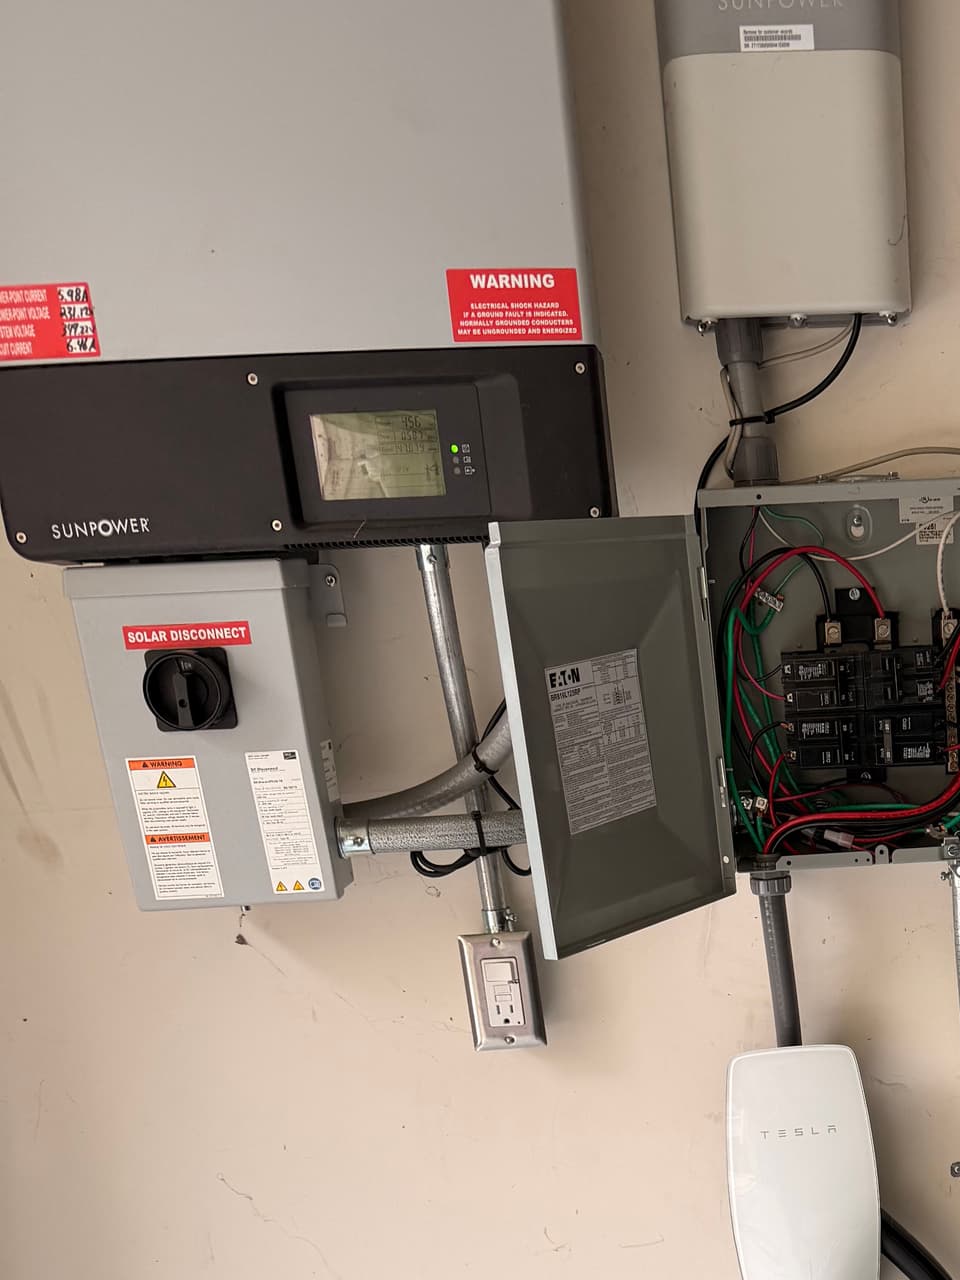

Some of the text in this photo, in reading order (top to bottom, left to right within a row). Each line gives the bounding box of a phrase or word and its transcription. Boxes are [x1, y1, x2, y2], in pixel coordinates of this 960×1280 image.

[469, 273, 556, 289] WARNING
[50, 517, 150, 540] SUNPOWER
[127, 626, 247, 643] SOLAR DISCONNECT
[150, 760, 183, 768] WARNING
[158, 834, 205, 842] AVERTISSEMENT
[760, 1124, 837, 1140] TESLA
